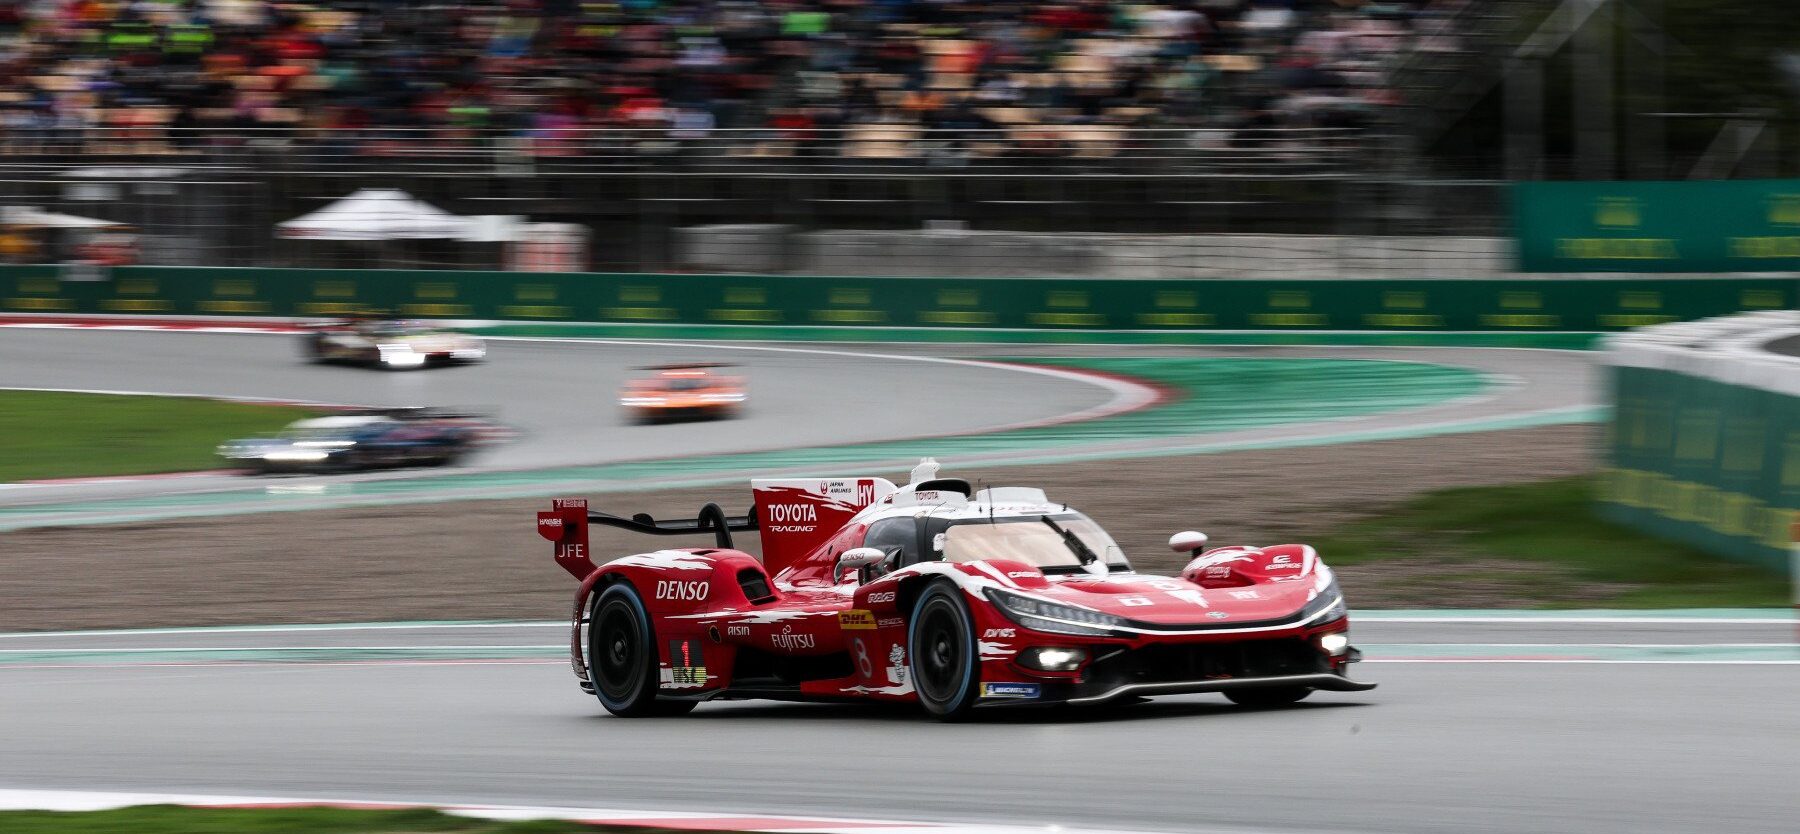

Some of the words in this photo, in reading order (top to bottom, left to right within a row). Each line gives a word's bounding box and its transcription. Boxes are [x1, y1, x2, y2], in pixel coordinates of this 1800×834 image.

[858, 484, 874, 506] HY
[915, 492, 939, 501] TOYOTA
[767, 503, 817, 522] TOYOTA
[558, 543, 584, 558] JFE
[656, 580, 709, 600] DENSO
[867, 591, 896, 603] RAYS
[841, 614, 869, 624] DHL
[727, 626, 750, 636] AISIN
[771, 633, 815, 652] FUJITSU
[681, 641, 689, 668] 1
[854, 637, 872, 679] 8
